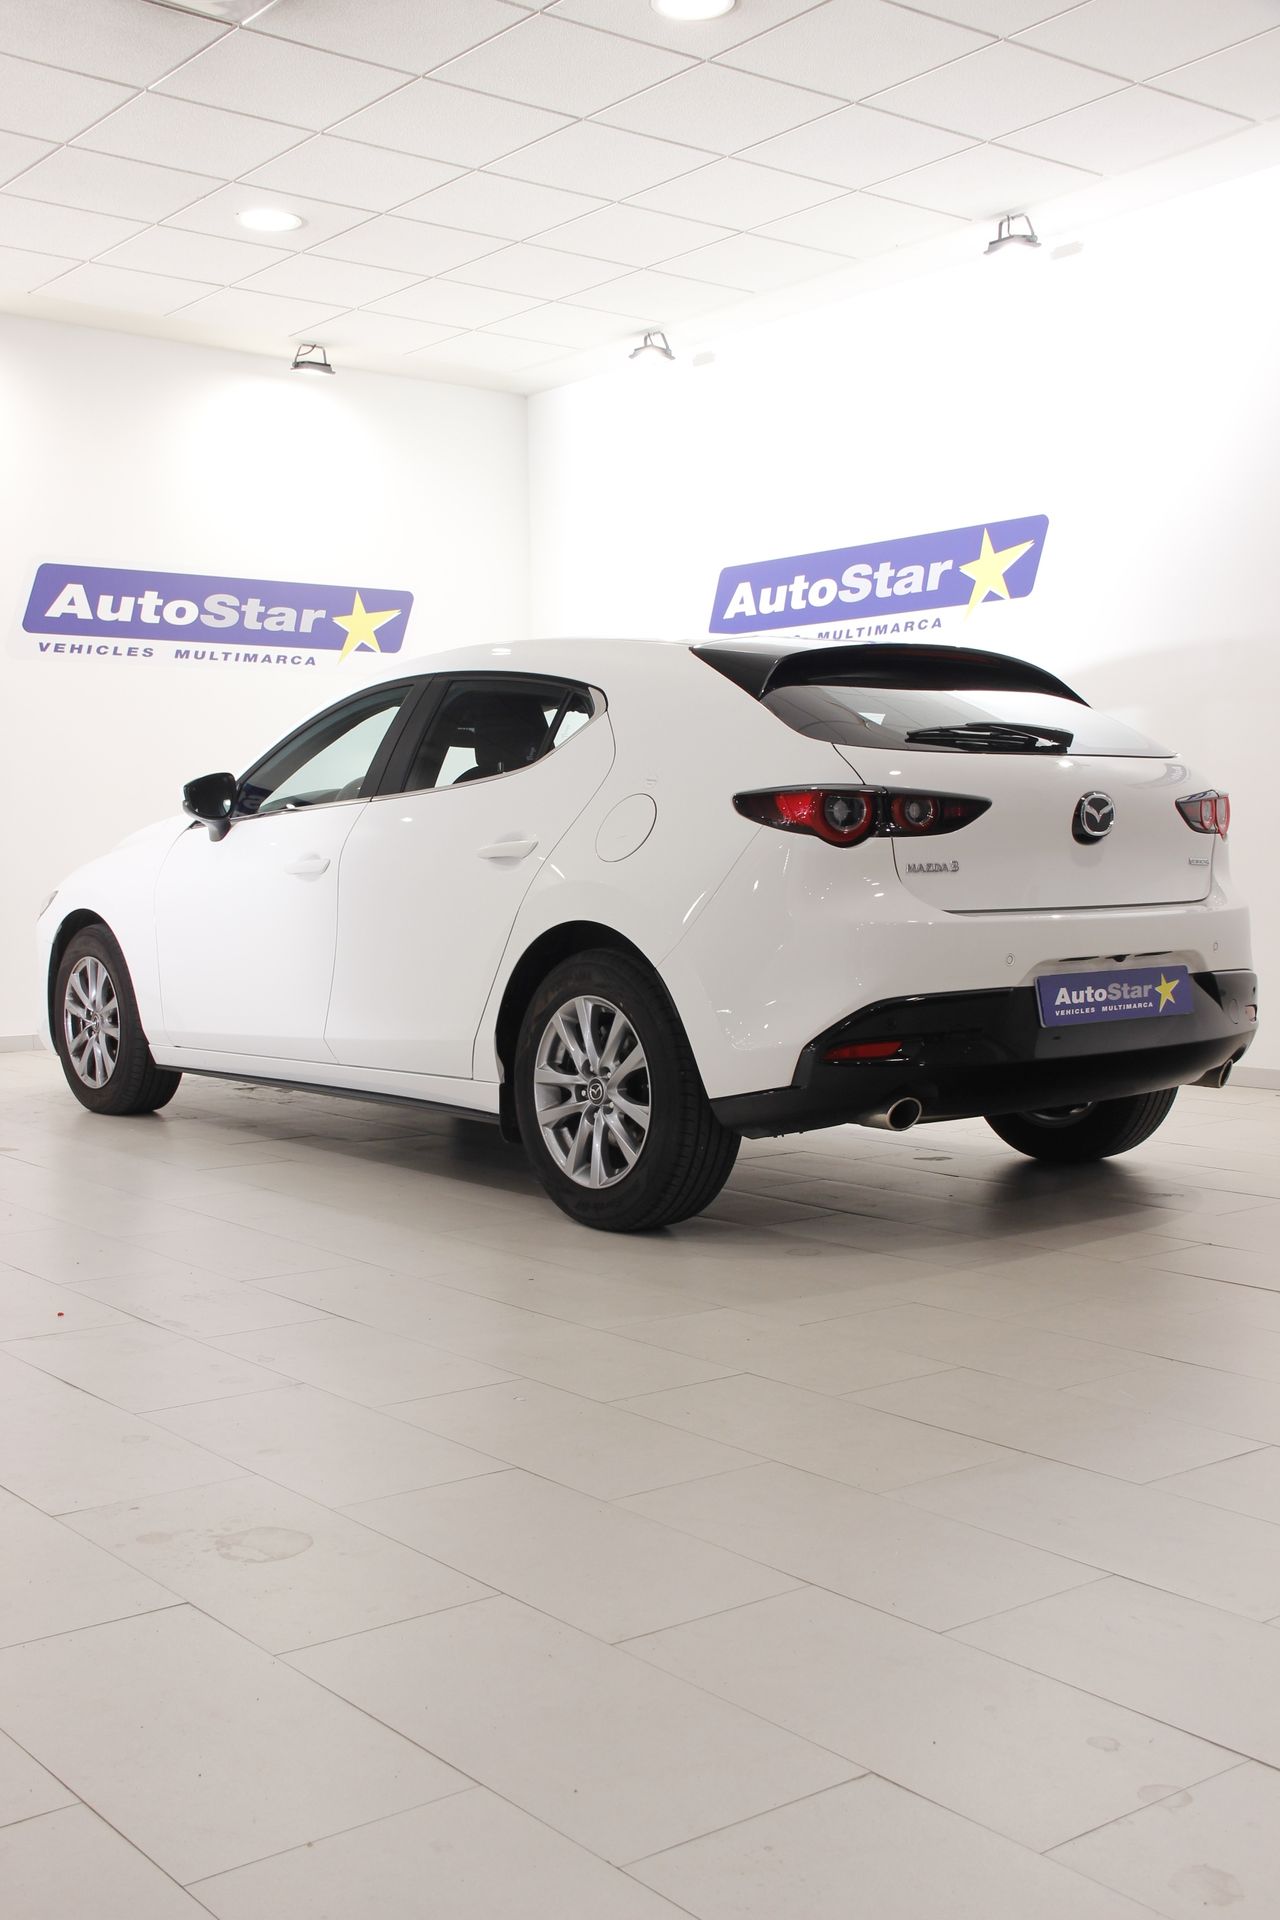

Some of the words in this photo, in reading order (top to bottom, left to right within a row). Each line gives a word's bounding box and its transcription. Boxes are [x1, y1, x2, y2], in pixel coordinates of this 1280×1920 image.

[723, 559, 953, 620] AutoStar
[45, 583, 326, 634] AutoStar
[817, 617, 942, 640] MULTIMARCA
[38, 642, 154, 658] VEHICLES
[175, 649, 316, 666] MULTIMARCA
[1054, 983, 1152, 1006] AutoStar
[1055, 1006, 1096, 1016] VEHICLES
[1101, 1002, 1154, 1012] MULTIMARCA
